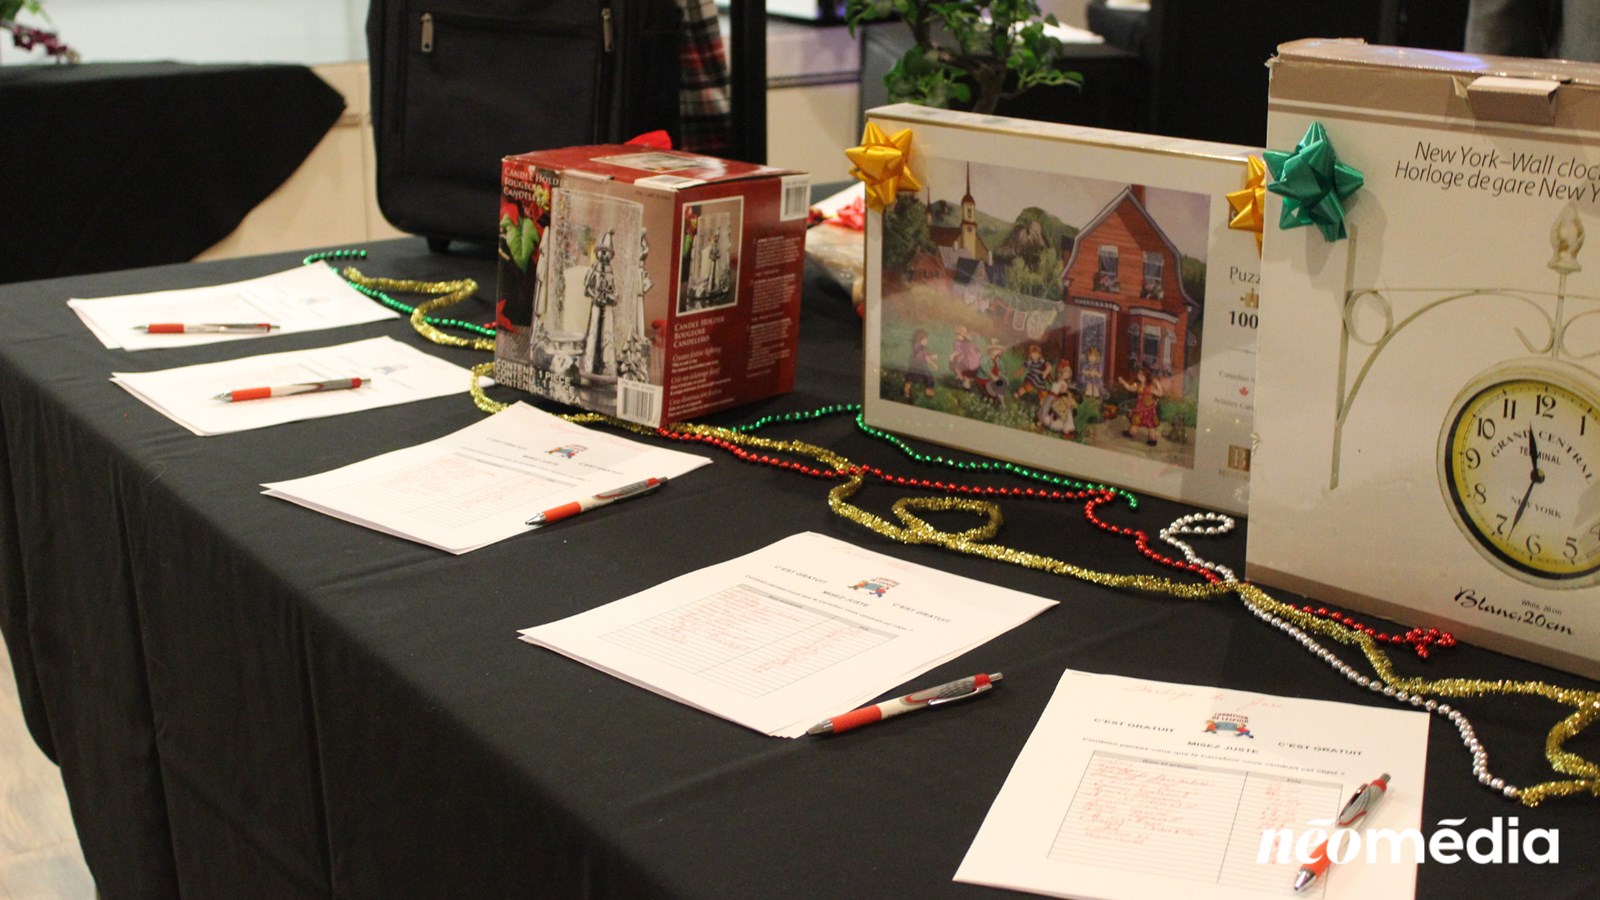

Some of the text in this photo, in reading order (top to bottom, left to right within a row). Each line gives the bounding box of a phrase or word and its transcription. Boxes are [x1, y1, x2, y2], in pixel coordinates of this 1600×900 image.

[1414, 141, 1457, 164] New
[1557, 157, 1600, 181] cloc
[1394, 160, 1464, 190] Horloge
[1467, 170, 1490, 190] de
[1492, 177, 1535, 197] gare
[1538, 177, 1586, 201] New
[1503, 398, 1516, 420] 11
[1535, 394, 1556, 419] 12
[1477, 417, 1496, 440] 10
[1580, 415, 1586, 436] 1
[1465, 447, 1481, 470] 9
[1473, 483, 1487, 505] 8
[1496, 513, 1508, 535] 7
[1526, 534, 1541, 556] 6
[1563, 536, 1577, 560] 5
